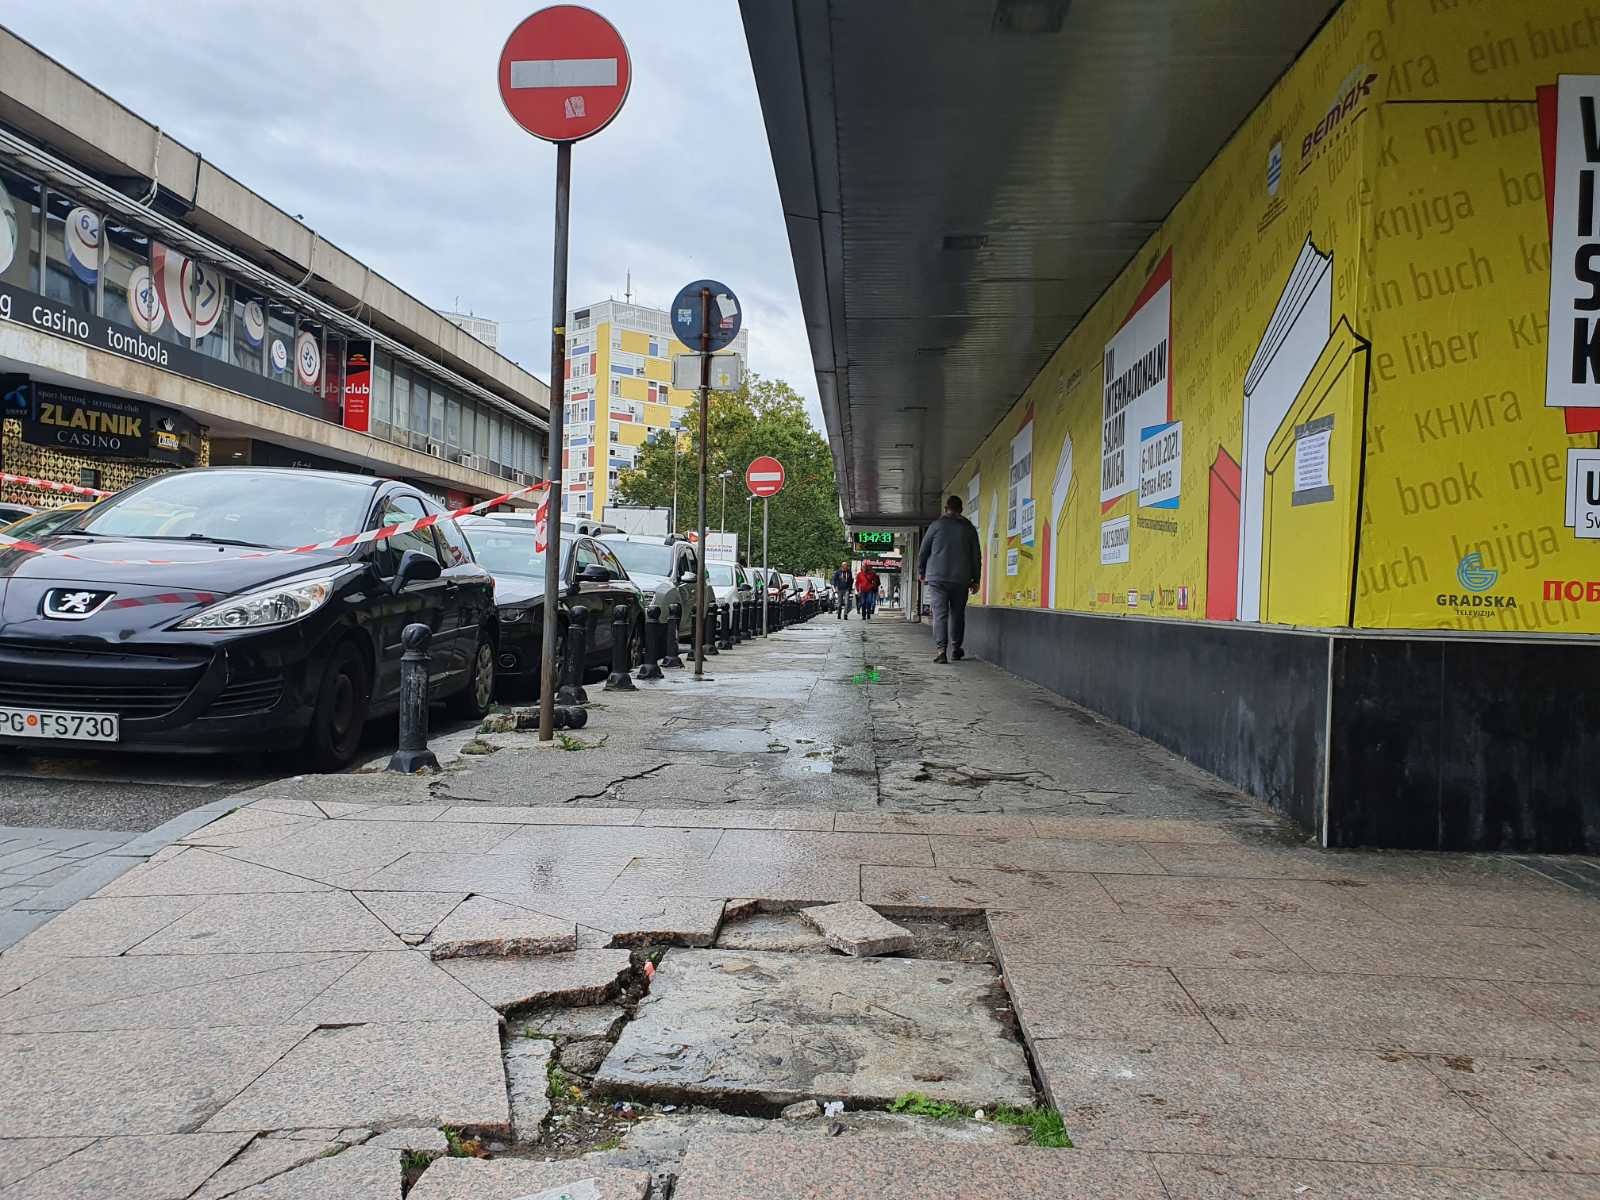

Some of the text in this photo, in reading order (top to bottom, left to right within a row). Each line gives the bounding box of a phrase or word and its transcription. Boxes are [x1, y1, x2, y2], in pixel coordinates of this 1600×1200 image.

[1425, 110, 1478, 160] nje
[1409, 247, 1495, 302] buch
[32, 302, 90, 340] casino
[106, 326, 169, 366] tombola
[1402, 330, 1480, 375] liber
[344, 383, 370, 394] club
[40, 402, 142, 438] ZLATNIK
[56, 430, 121, 450] CASINO
[1395, 446, 1563, 517] book nje
[1436, 593, 1519, 609] GRADSKA
[1455, 608, 1497, 618] TELEVIZIJA
[40, 714, 115, 738] FS730
